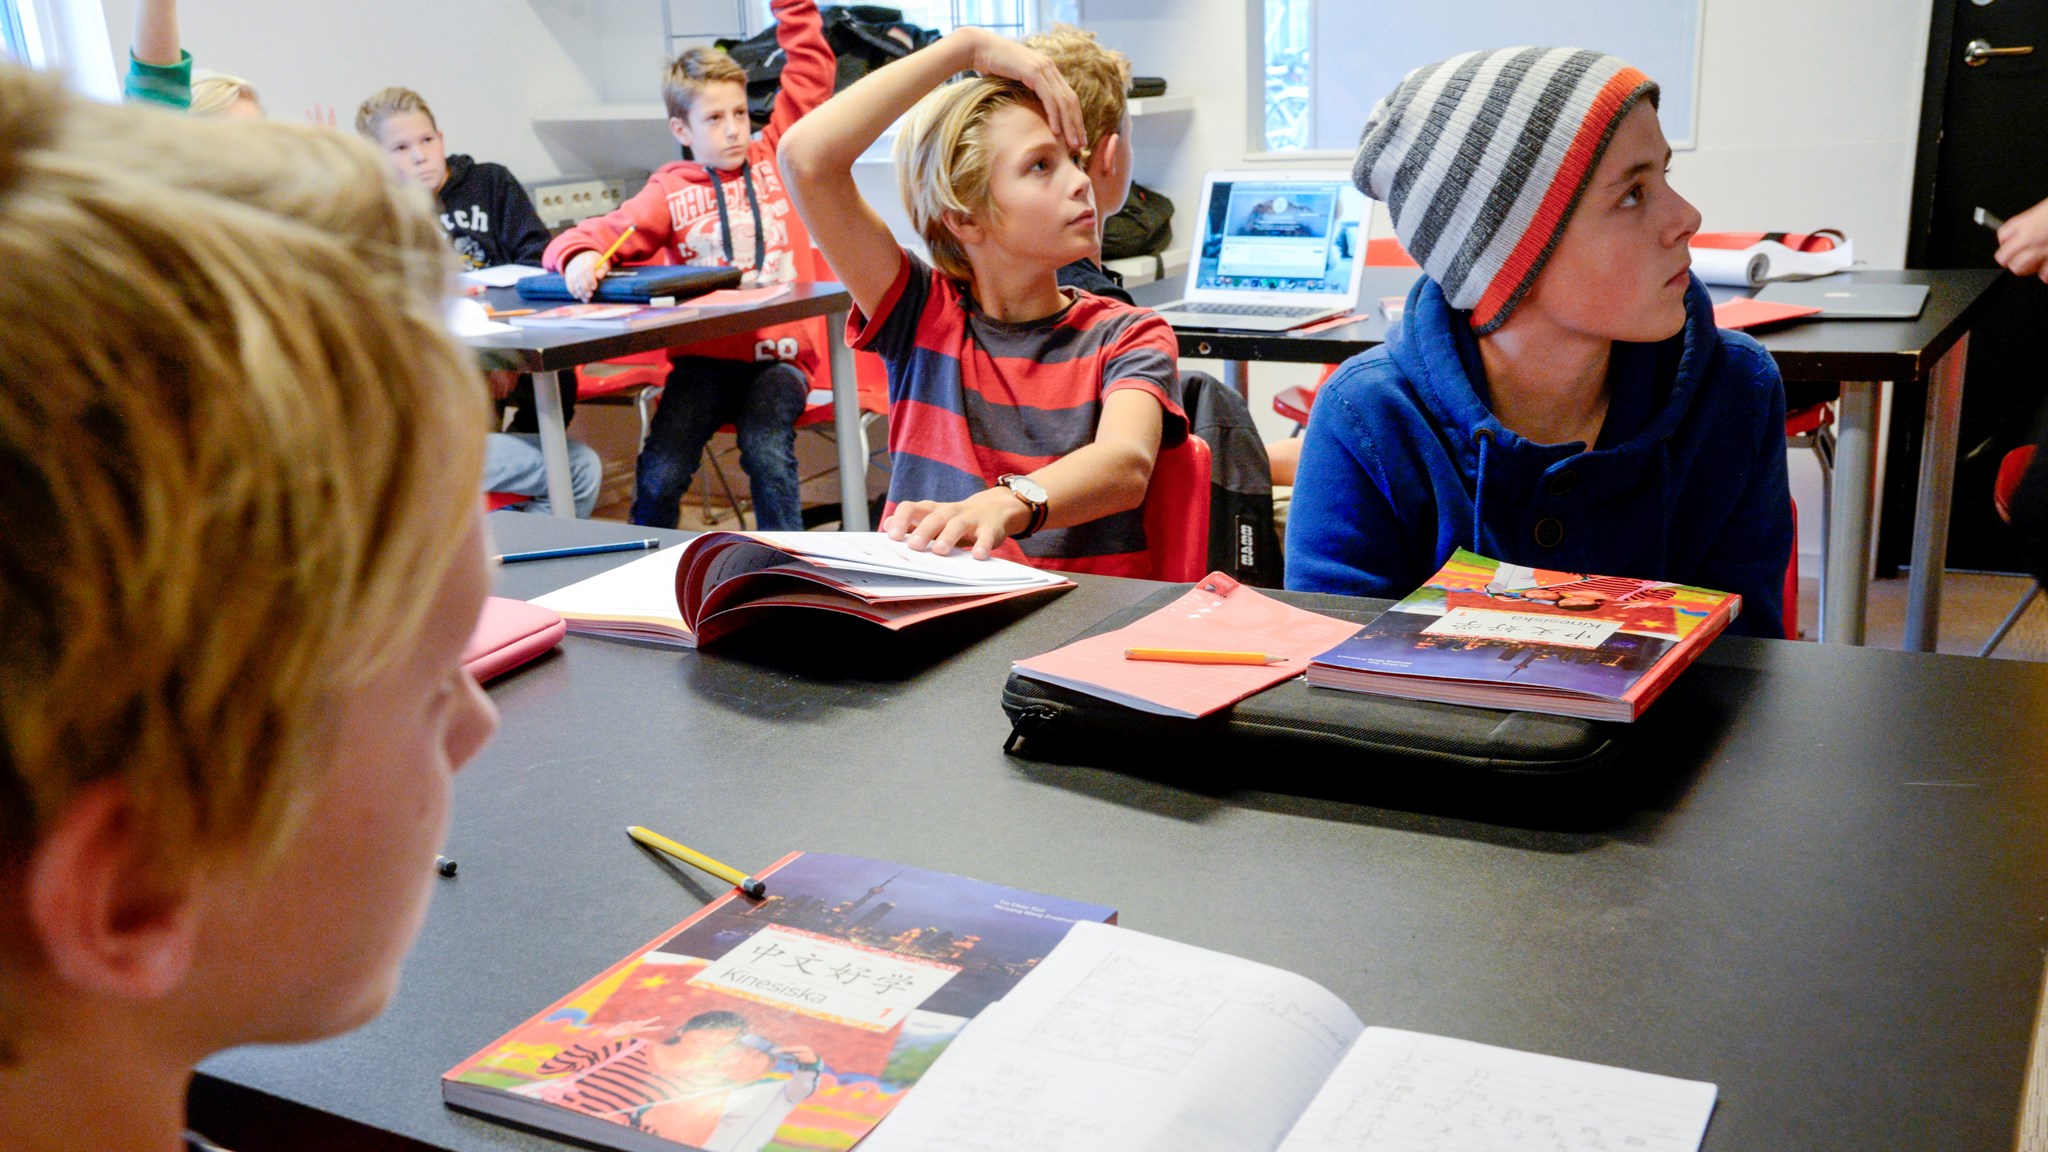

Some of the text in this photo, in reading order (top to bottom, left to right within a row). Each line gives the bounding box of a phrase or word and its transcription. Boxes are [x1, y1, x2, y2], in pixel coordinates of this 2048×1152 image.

[1511, 615, 1602, 629] Kinesiska
[719, 967, 828, 1005] Kinesiska
[879, 1007, 894, 1019] 1
